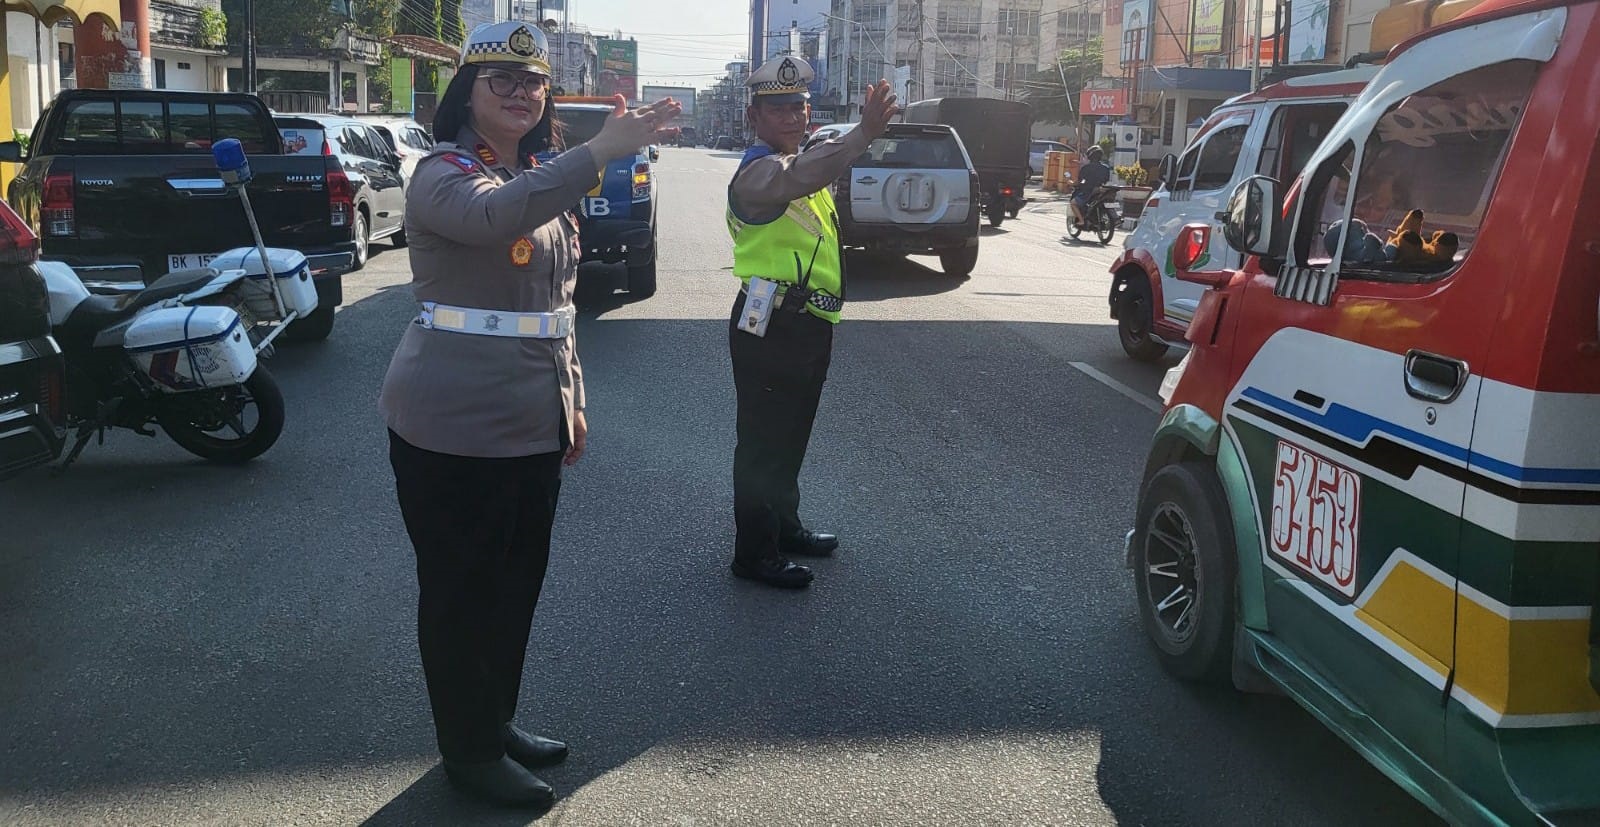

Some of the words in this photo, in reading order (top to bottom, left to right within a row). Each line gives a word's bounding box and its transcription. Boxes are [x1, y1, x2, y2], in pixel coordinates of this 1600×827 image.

[171, 255, 187, 269] BK
[198, 254, 218, 268] 15
[1273, 443, 1358, 587] 5453
